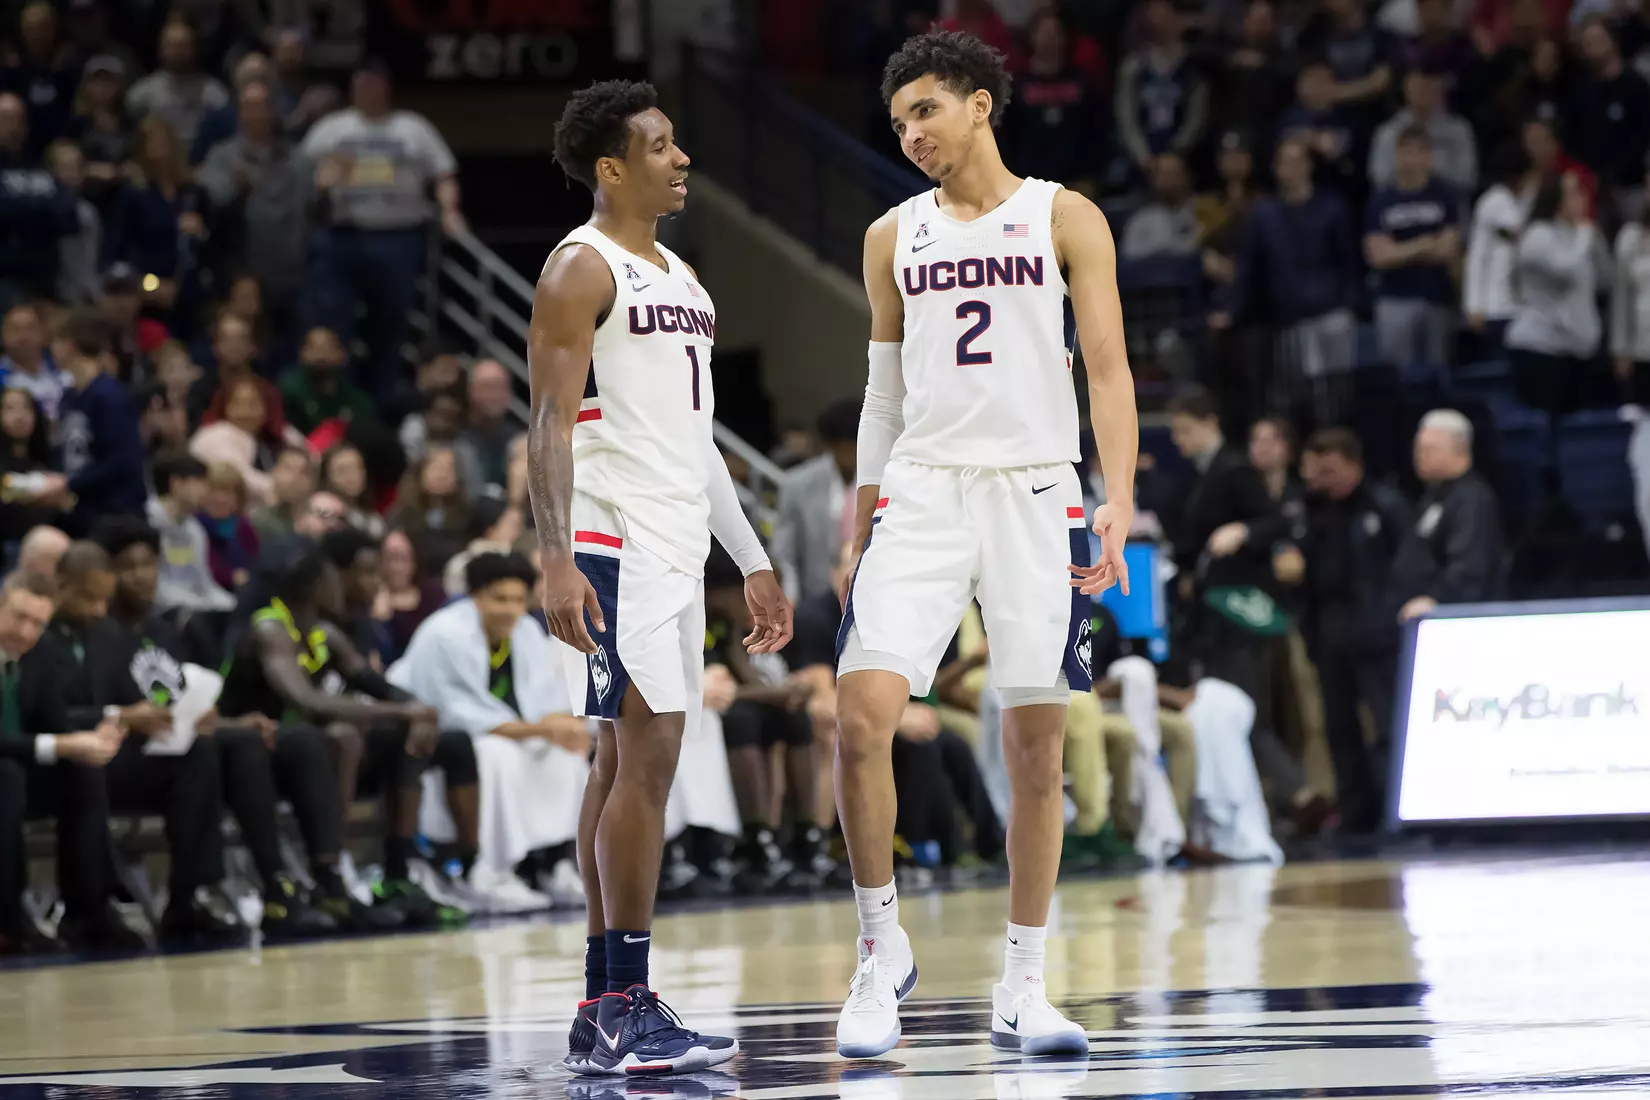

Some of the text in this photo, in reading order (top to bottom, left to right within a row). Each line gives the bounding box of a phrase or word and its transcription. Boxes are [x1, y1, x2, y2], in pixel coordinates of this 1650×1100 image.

[427, 33, 578, 79] zero
[903, 256, 1044, 296] UCONN
[955, 300, 993, 366] 2
[685, 345, 701, 411] 1
